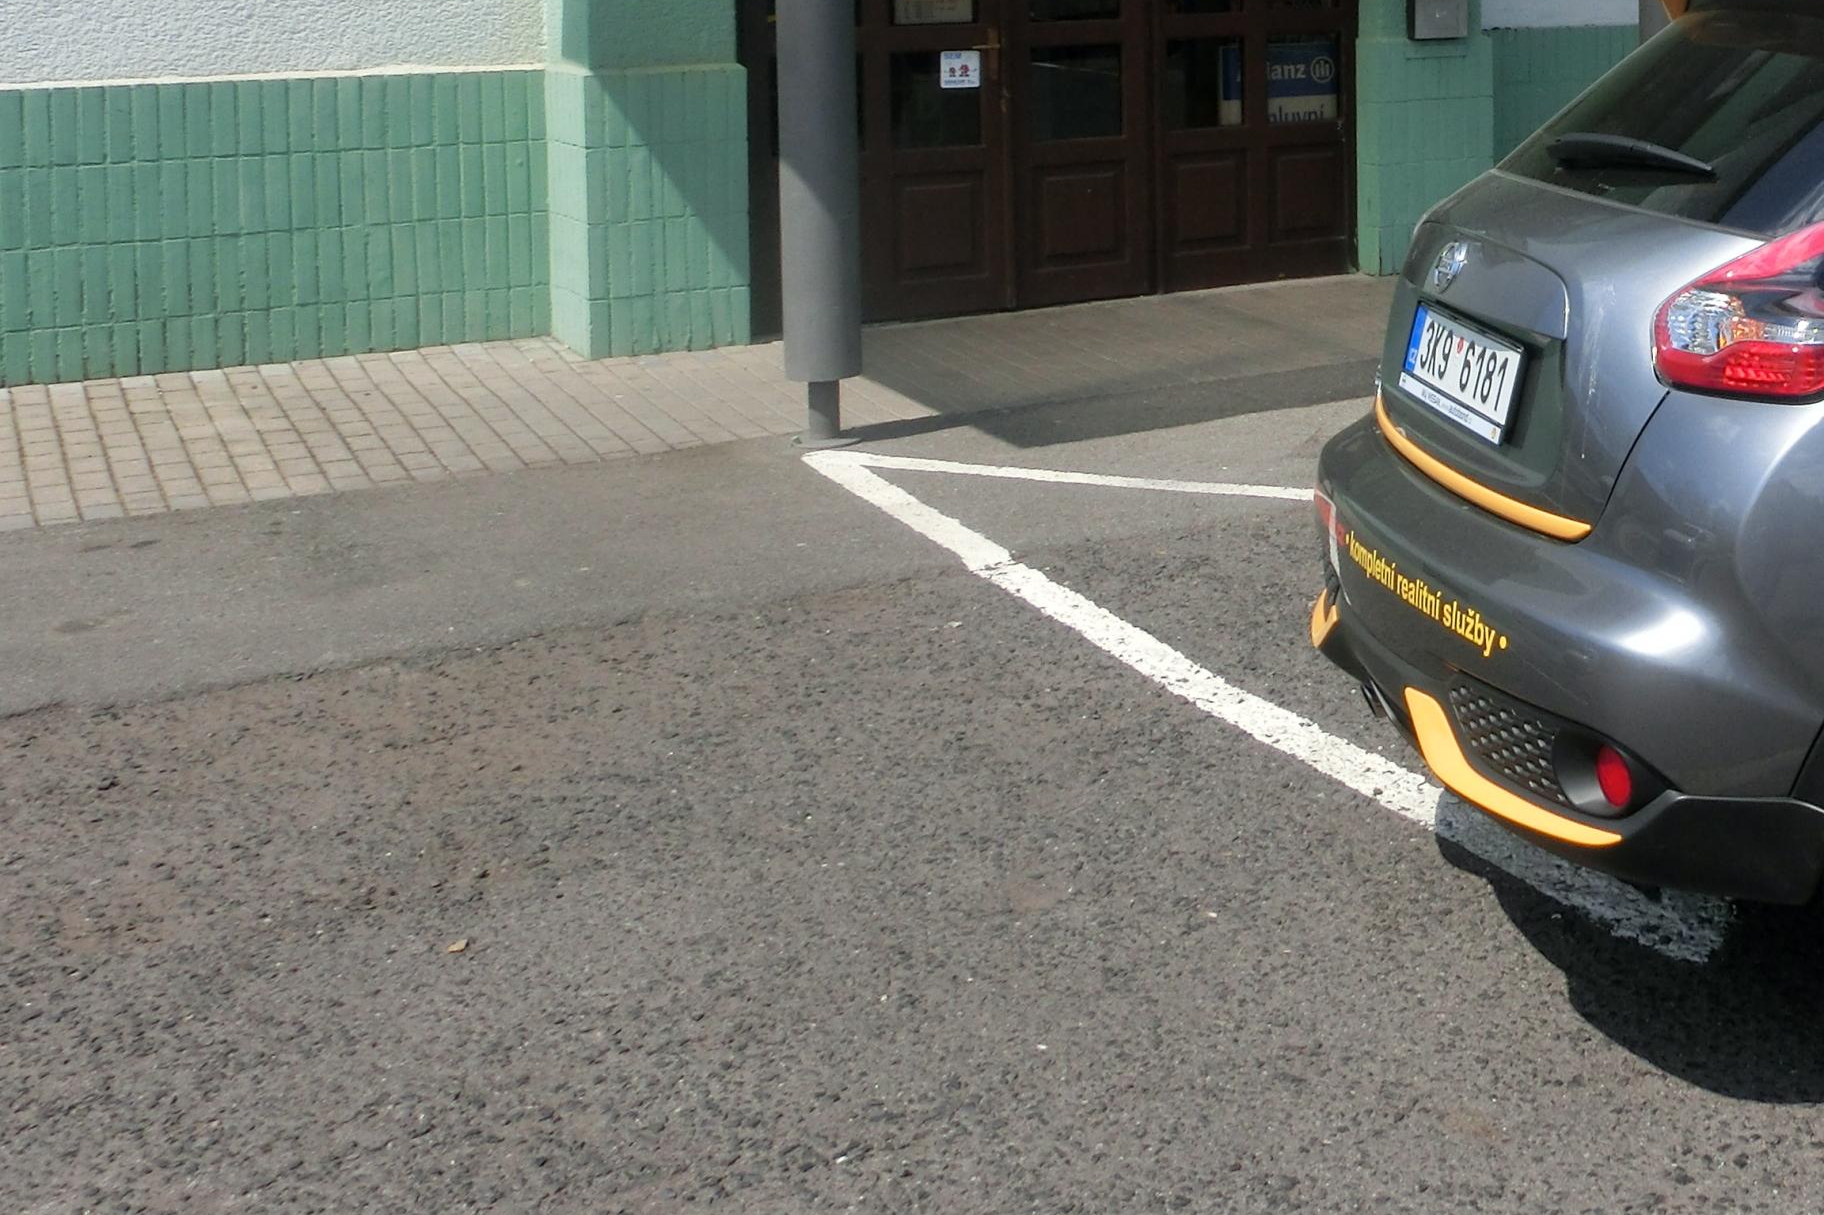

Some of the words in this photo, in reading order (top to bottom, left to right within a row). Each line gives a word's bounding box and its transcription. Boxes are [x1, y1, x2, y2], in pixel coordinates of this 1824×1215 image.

[1420, 321, 1454, 380] 3K9
[1459, 339, 1509, 412] 6181
[1349, 530, 1397, 591] kompletní
[1396, 573, 1443, 620] realitní
[1442, 600, 1496, 657] služby
